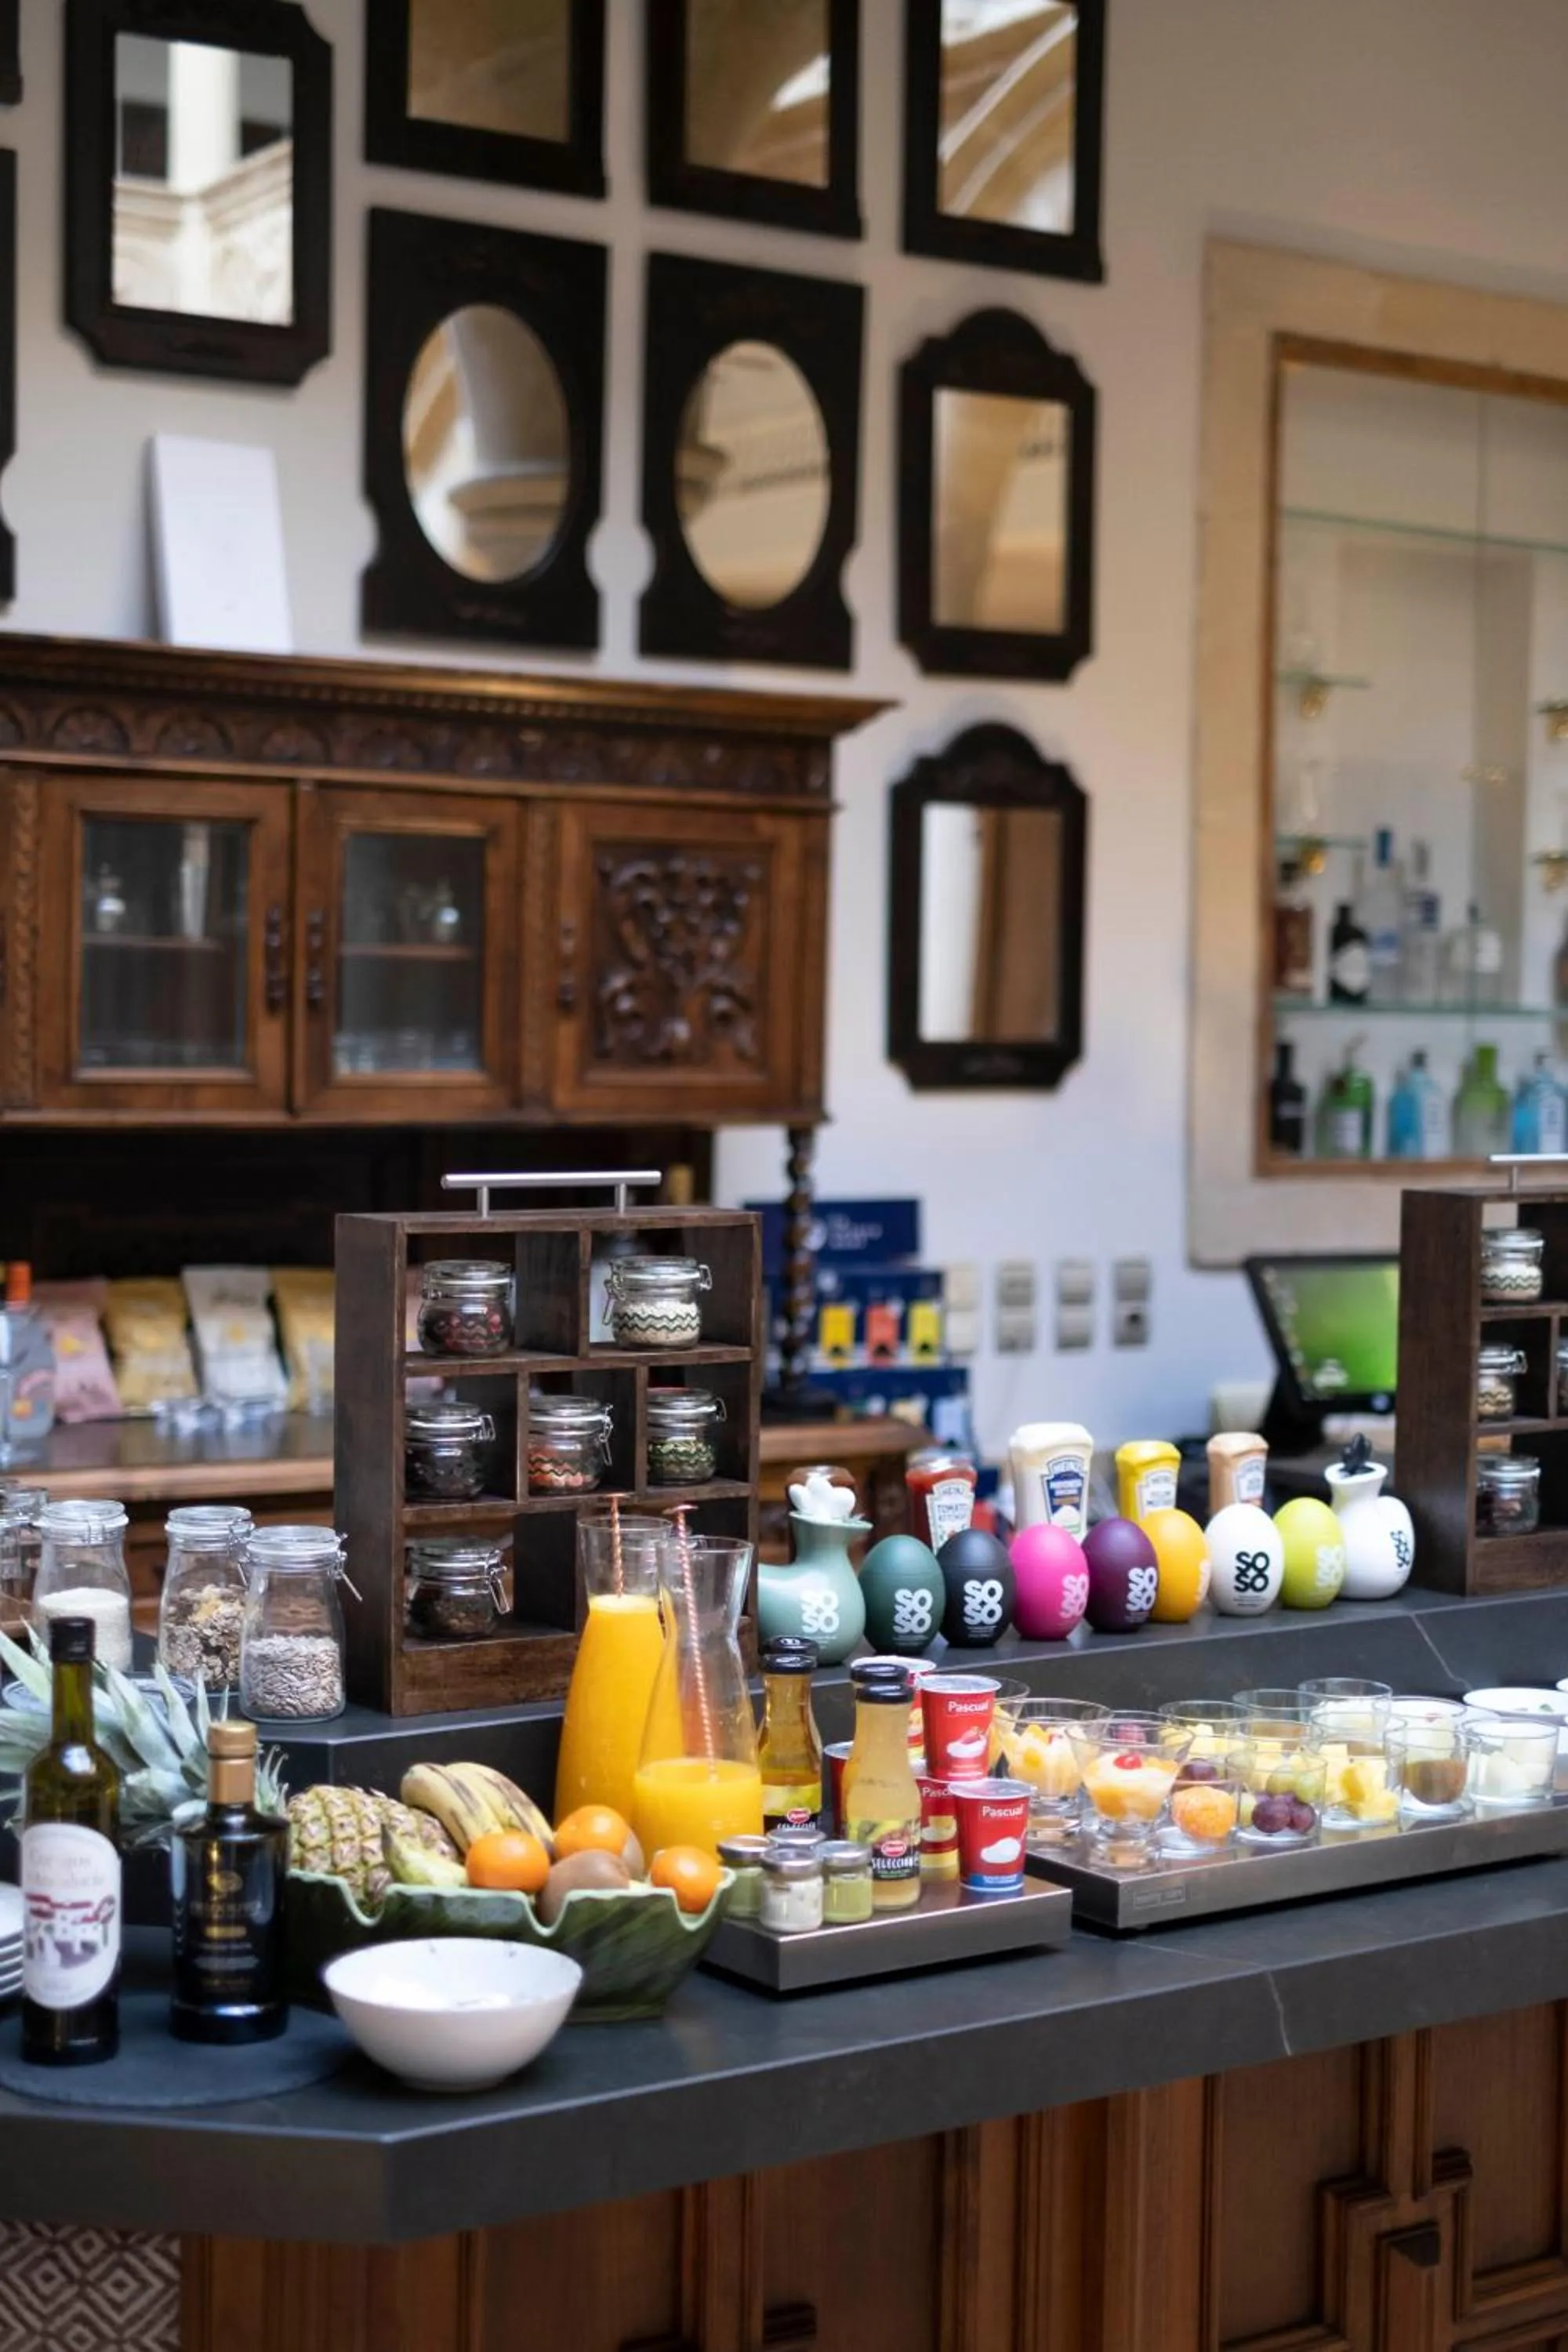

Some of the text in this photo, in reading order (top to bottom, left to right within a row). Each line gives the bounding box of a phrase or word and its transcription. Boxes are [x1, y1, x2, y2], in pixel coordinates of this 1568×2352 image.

[1235, 1551, 1270, 1572] SO
[1062, 1573, 1089, 1595] SO
[1127, 1566, 1158, 1589] SO
[1234, 1572, 1269, 1593] SO
[799, 1590, 839, 1611] SO
[894, 1588, 933, 1611] SO
[964, 1579, 1004, 1602] SO
[1126, 1588, 1156, 1612] SO
[963, 1601, 1004, 1625] SO
[1059, 1595, 1089, 1619] SO
[801, 1610, 840, 1634] SO
[892, 1610, 932, 1634] SO
[947, 1699, 989, 1713] Pascual
[982, 1803, 1024, 1817] Pascual
